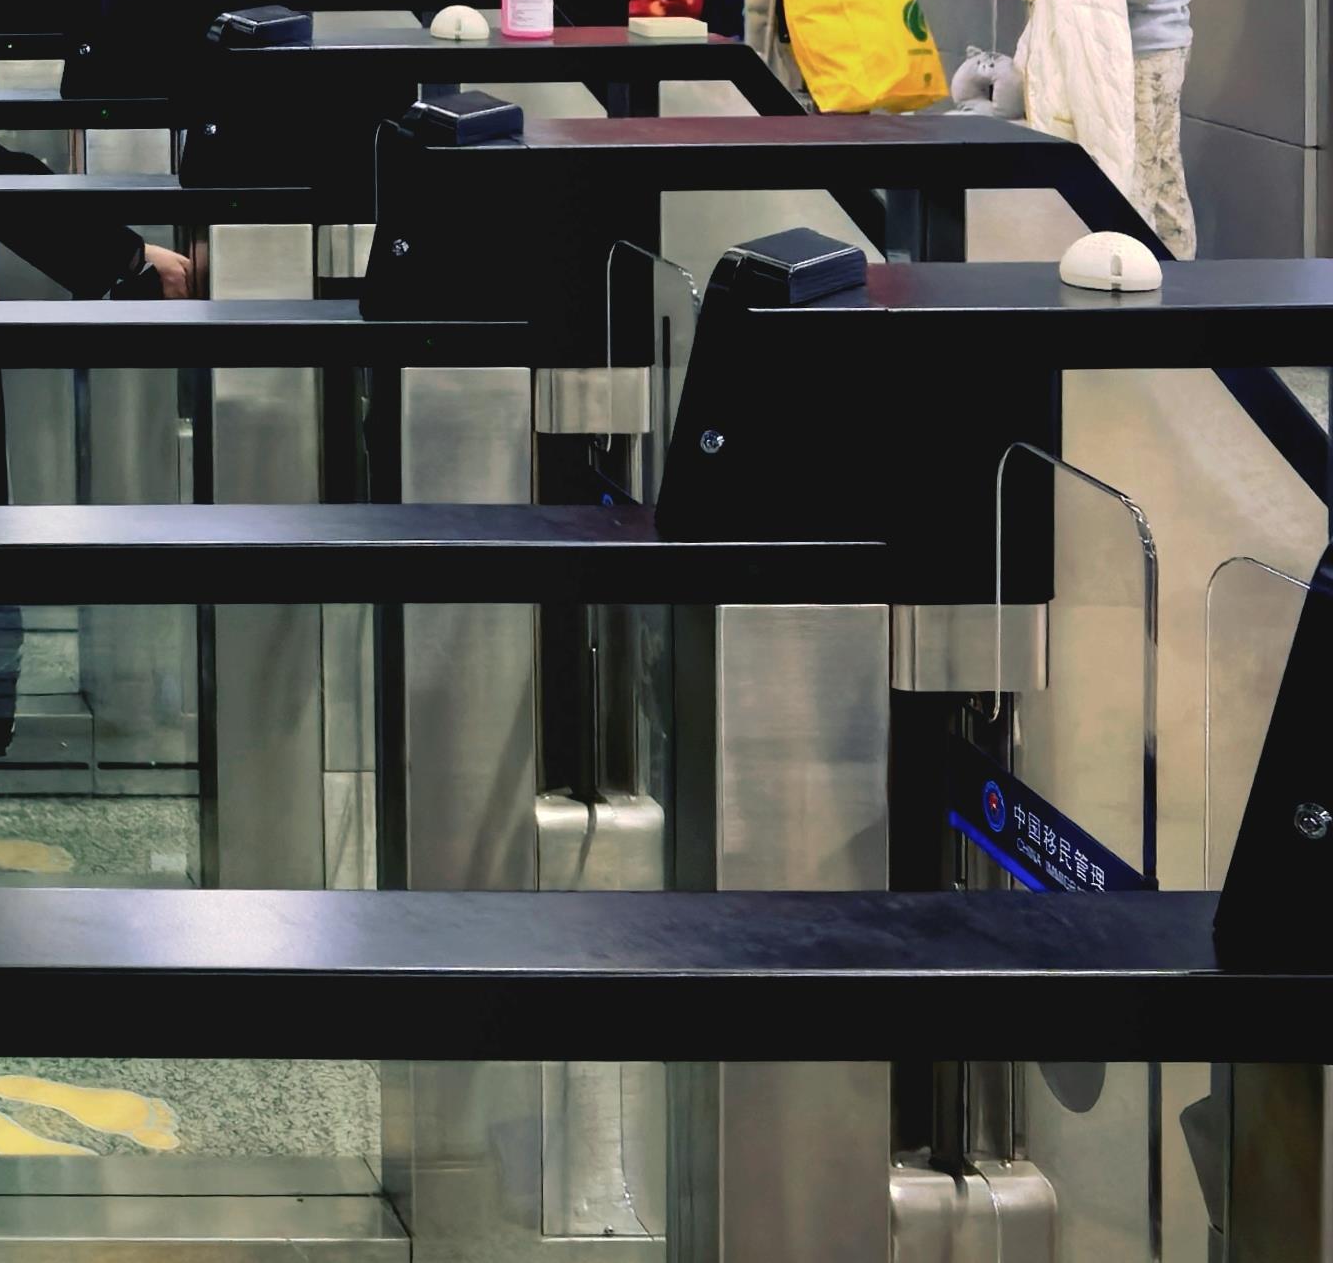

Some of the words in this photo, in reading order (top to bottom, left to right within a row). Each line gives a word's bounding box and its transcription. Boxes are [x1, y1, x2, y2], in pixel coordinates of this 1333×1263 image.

[1014, 803, 1105, 892] 中国移民管理
[1016, 837, 1042, 867] CHINA
